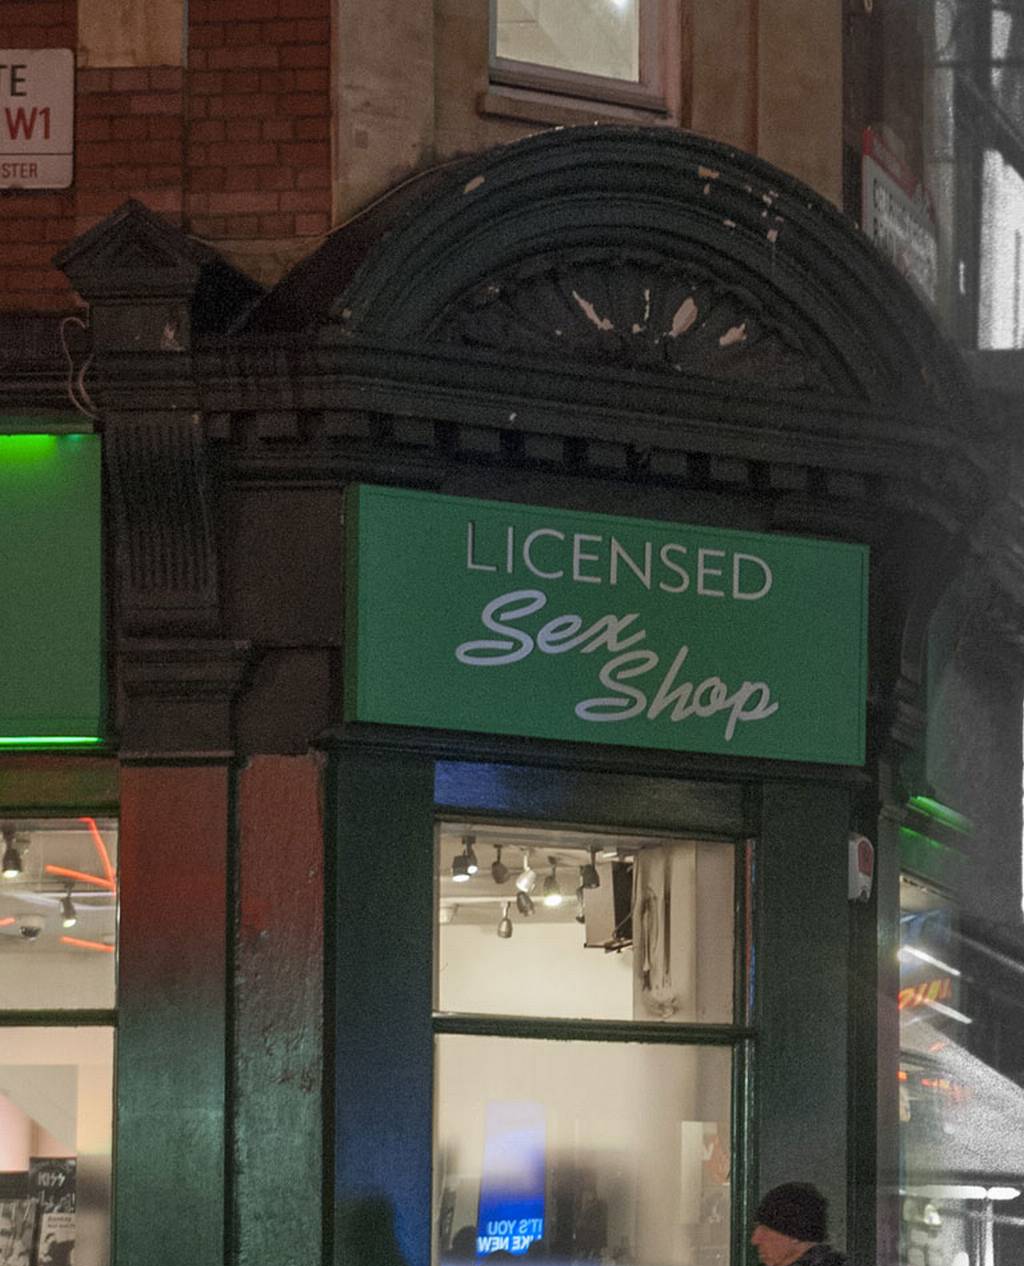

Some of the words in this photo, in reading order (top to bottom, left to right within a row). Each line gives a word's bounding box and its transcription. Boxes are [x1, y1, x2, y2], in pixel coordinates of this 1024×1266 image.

[4, 106, 51, 140] W1
[466, 521, 774, 600] LICENSED
[455, 589, 646, 666] Sex
[574, 645, 779, 742] Shop
[38, 1171, 66, 1188] KISS
